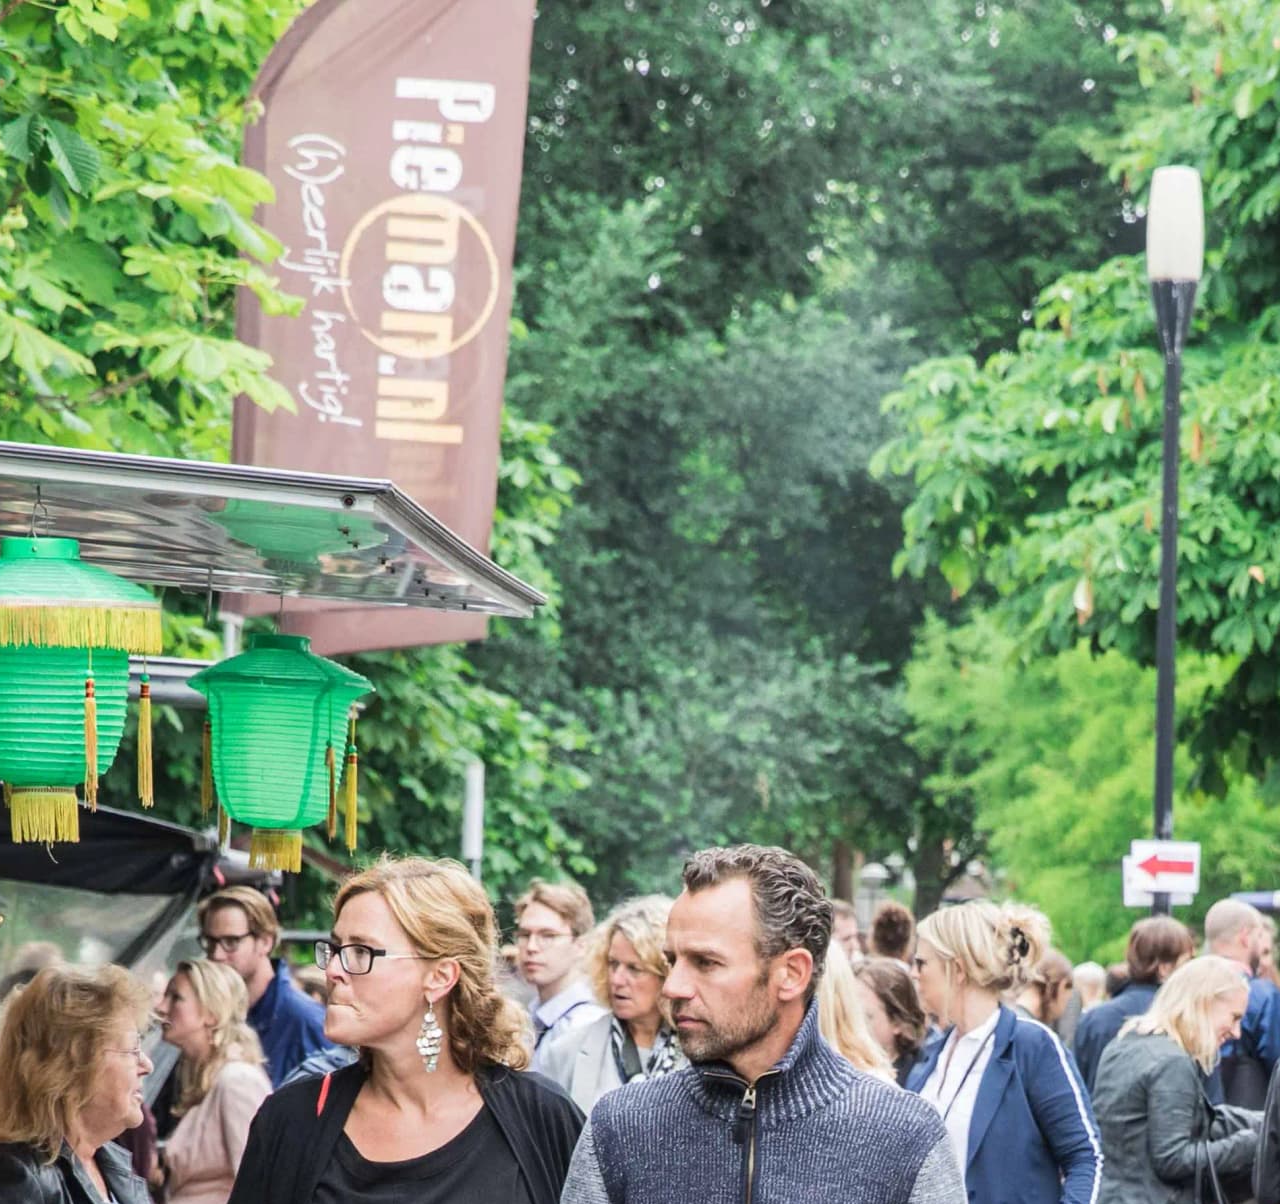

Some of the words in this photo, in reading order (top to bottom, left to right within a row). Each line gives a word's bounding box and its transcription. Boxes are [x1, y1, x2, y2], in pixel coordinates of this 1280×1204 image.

[279, 133, 351, 296] (h)eerlijk
[376, 77, 495, 444] Pieman.nl
[299, 309, 363, 428] hartig!
